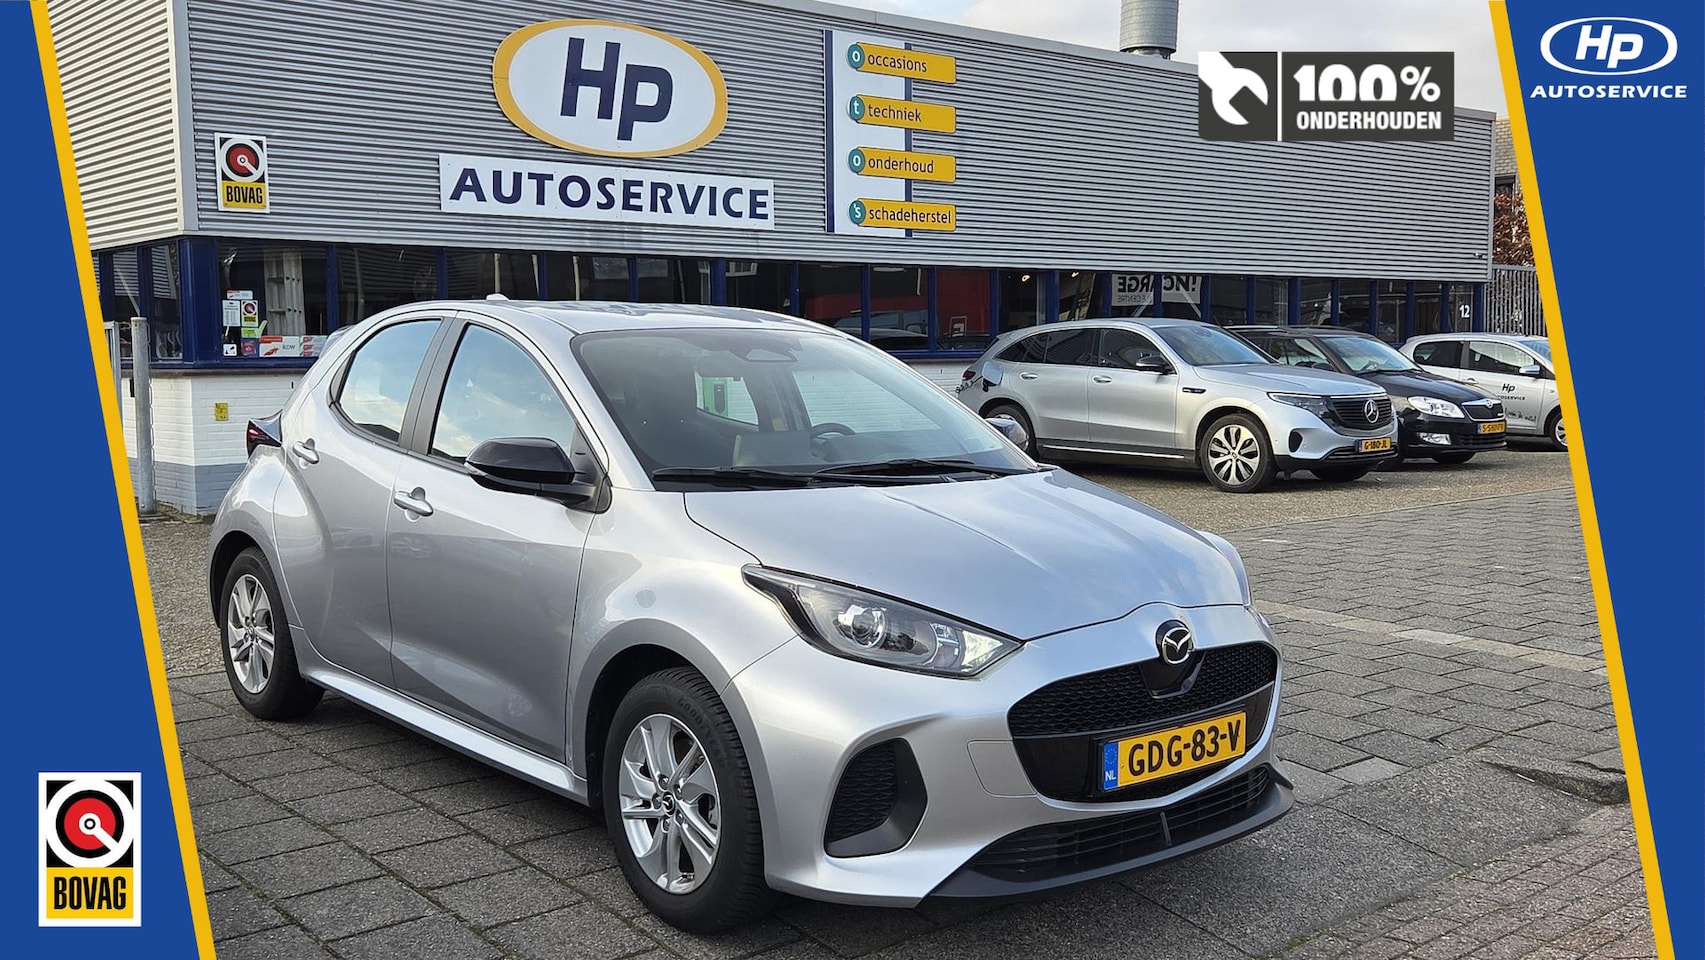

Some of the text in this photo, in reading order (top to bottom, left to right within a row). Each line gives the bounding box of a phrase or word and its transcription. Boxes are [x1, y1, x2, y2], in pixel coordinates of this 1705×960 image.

[867, 54, 927, 73] occasions
[560, 37, 673, 141] Hp
[868, 104, 922, 122] techniek
[868, 156, 934, 174] onderhoud
[226, 185, 263, 204] BOVAG
[449, 168, 769, 220] AUTOSERVICE
[869, 206, 951, 224] schadeherstel
[1459, 304, 1471, 318] 12
[1502, 383, 1516, 393] Hp
[1105, 719, 1241, 781] NL GDG-83-V
